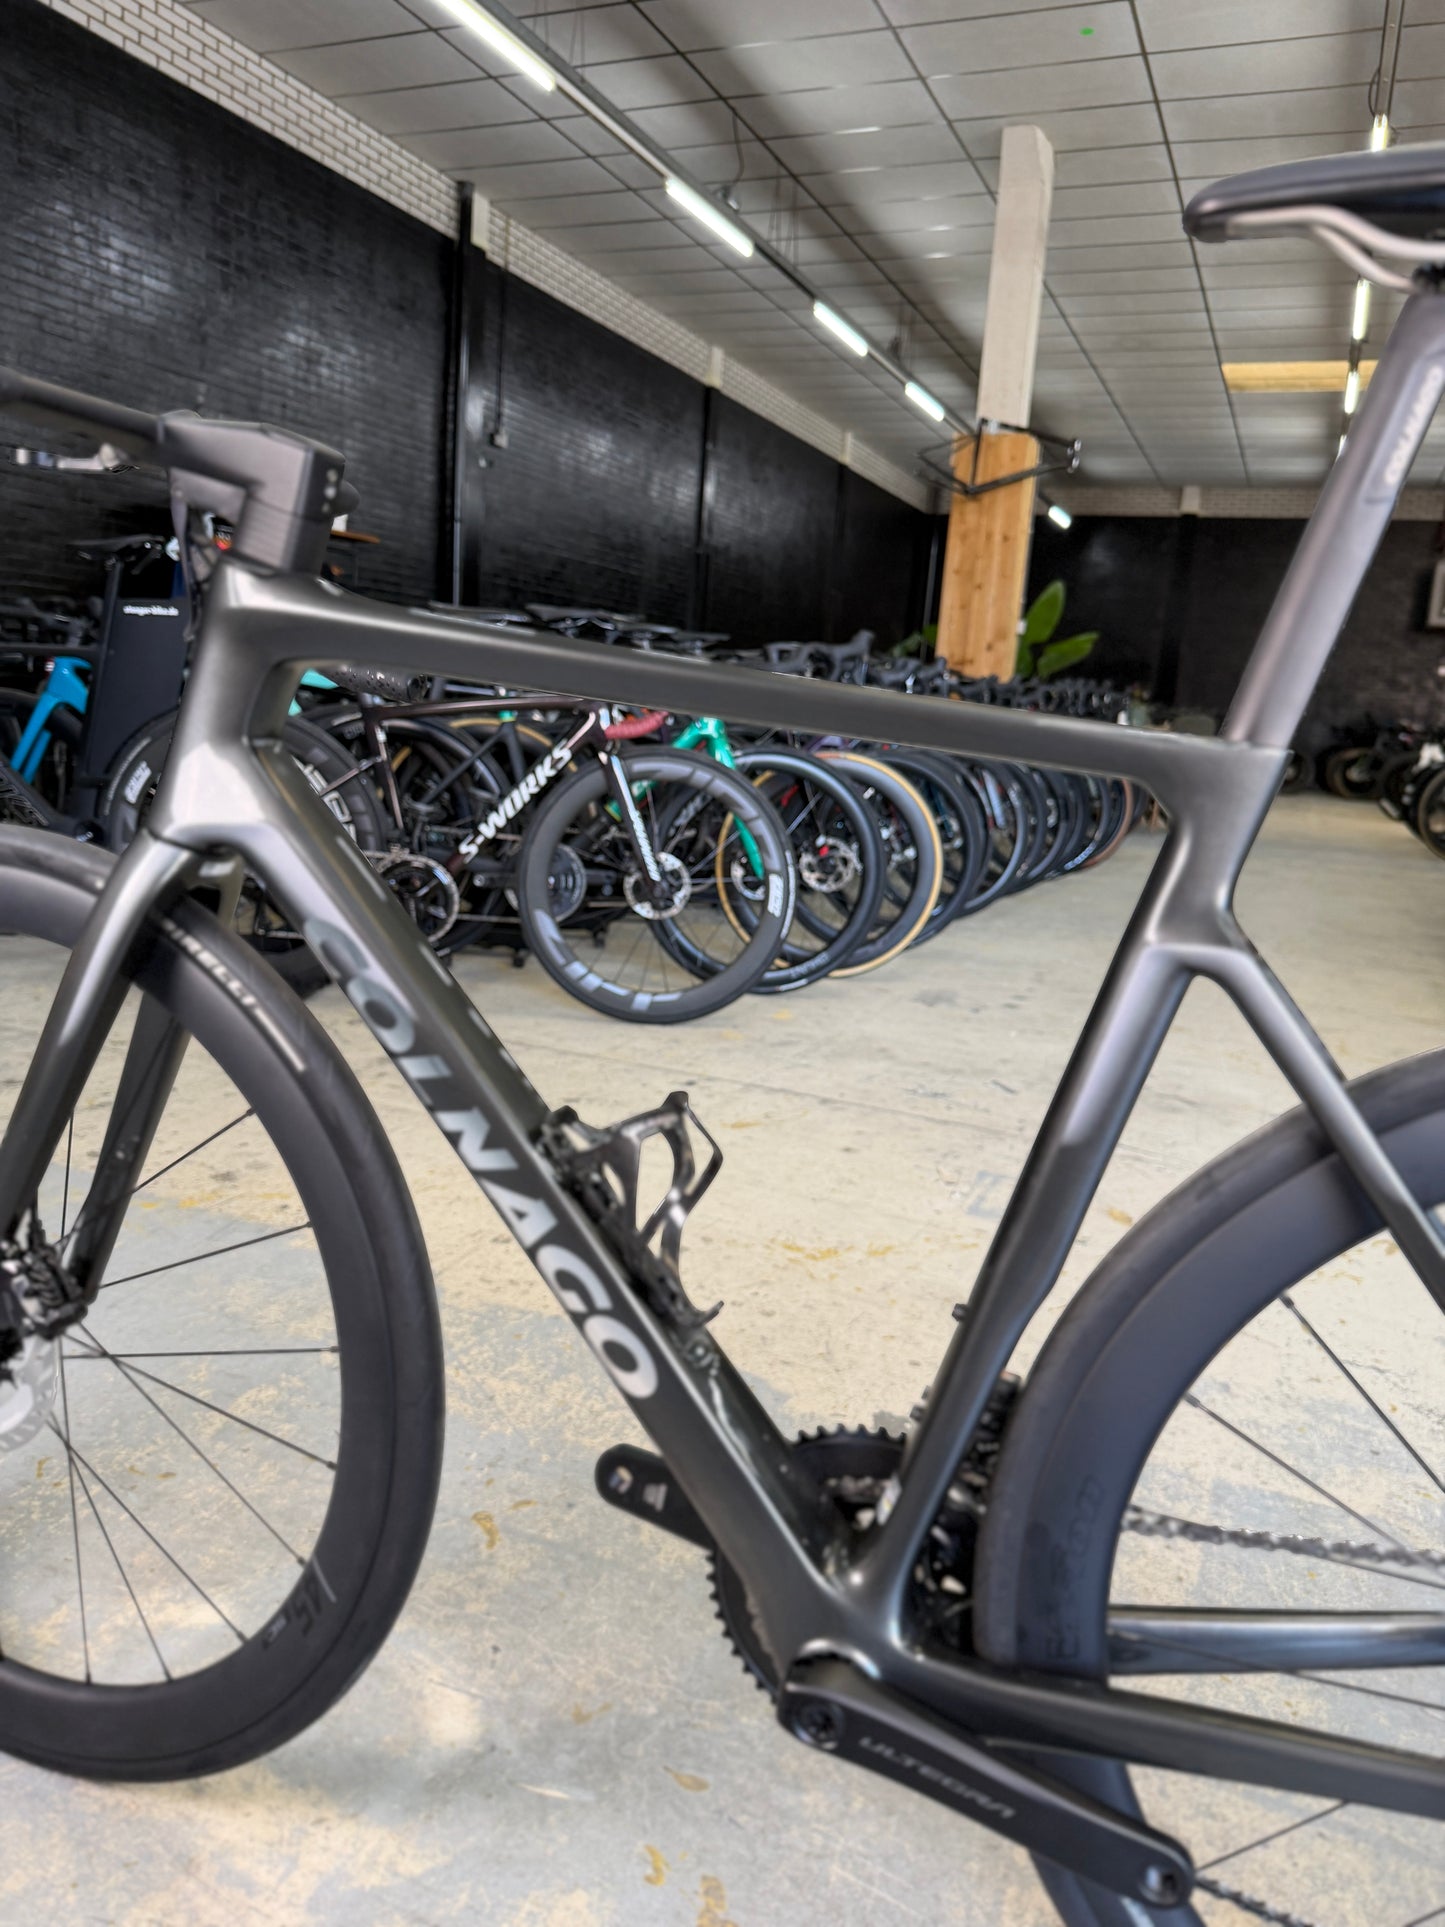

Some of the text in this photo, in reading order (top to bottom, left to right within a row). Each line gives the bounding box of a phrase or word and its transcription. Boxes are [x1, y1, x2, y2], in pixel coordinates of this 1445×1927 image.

[458, 738, 572, 864] S-WORKS
[302, 917, 659, 1399] COLNAGO
[857, 1735, 1017, 1820] ULTEGRA
